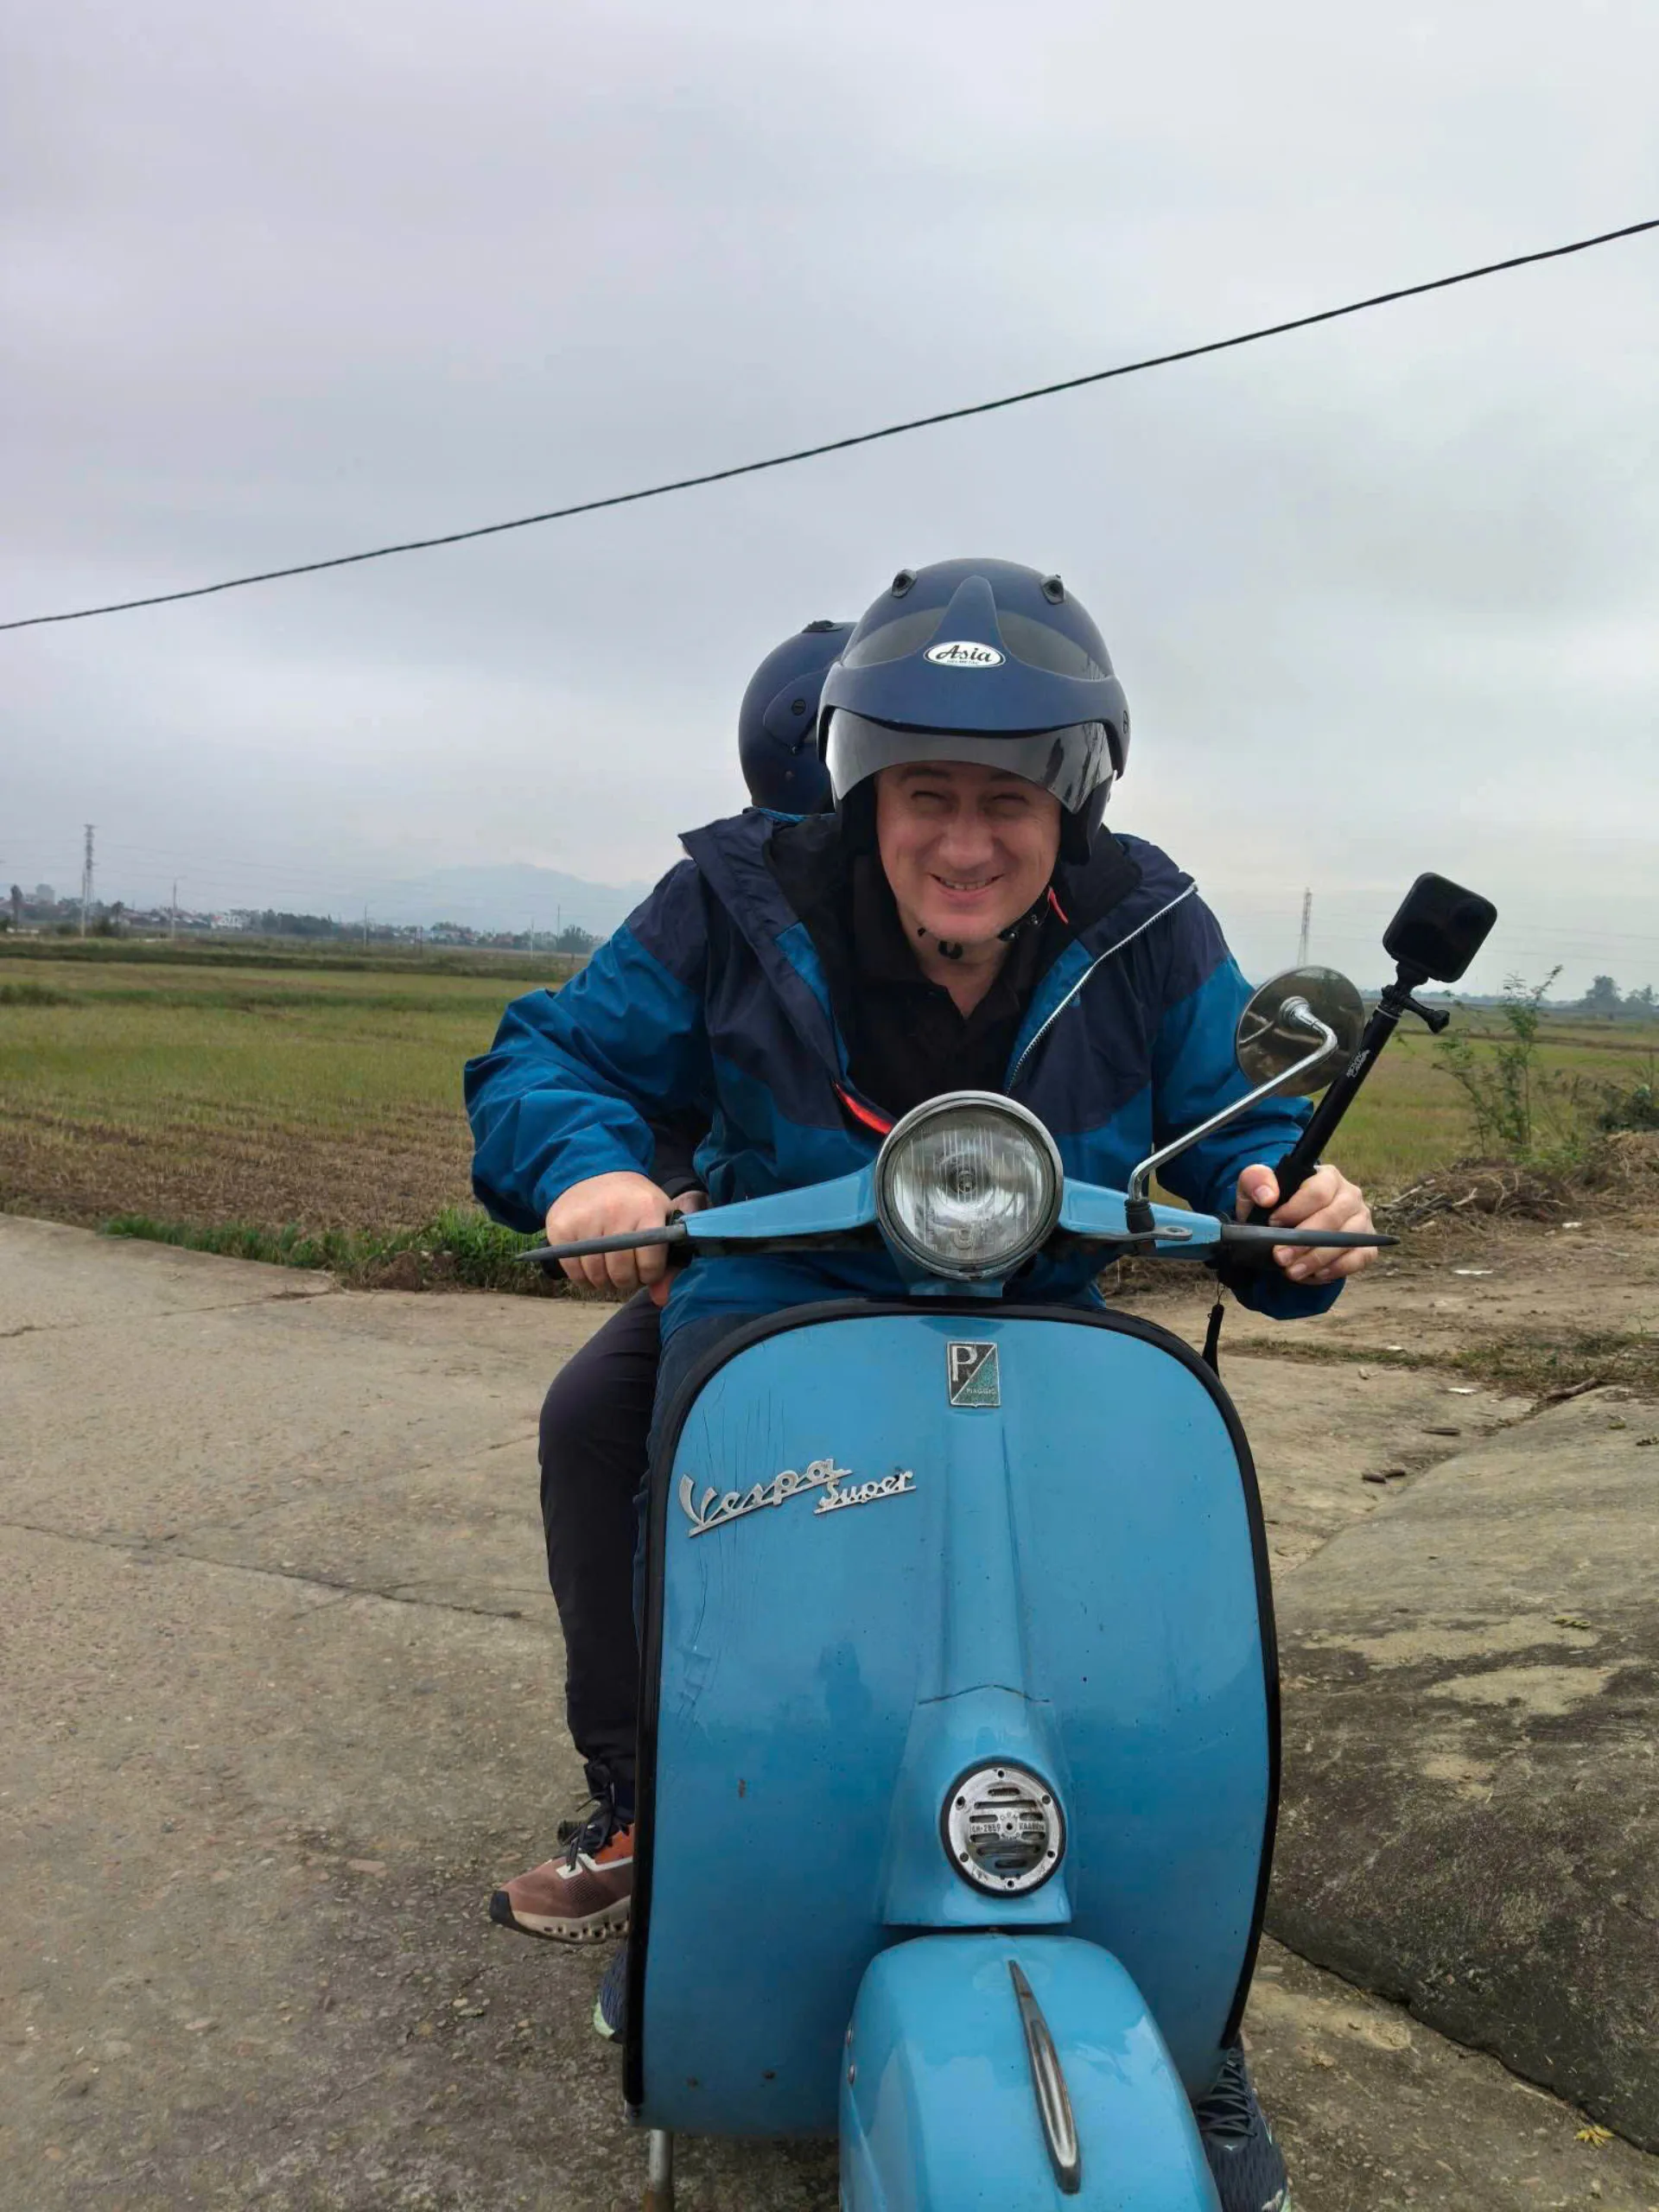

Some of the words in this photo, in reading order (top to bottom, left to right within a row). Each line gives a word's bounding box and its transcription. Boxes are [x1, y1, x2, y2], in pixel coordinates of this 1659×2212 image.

[935, 644, 993, 663] Asia
[950, 1344, 978, 1382] P
[965, 1387, 997, 1396] PIAGGIO
[679, 1458, 853, 1538] Vespa
[813, 1470, 917, 1515] Super
